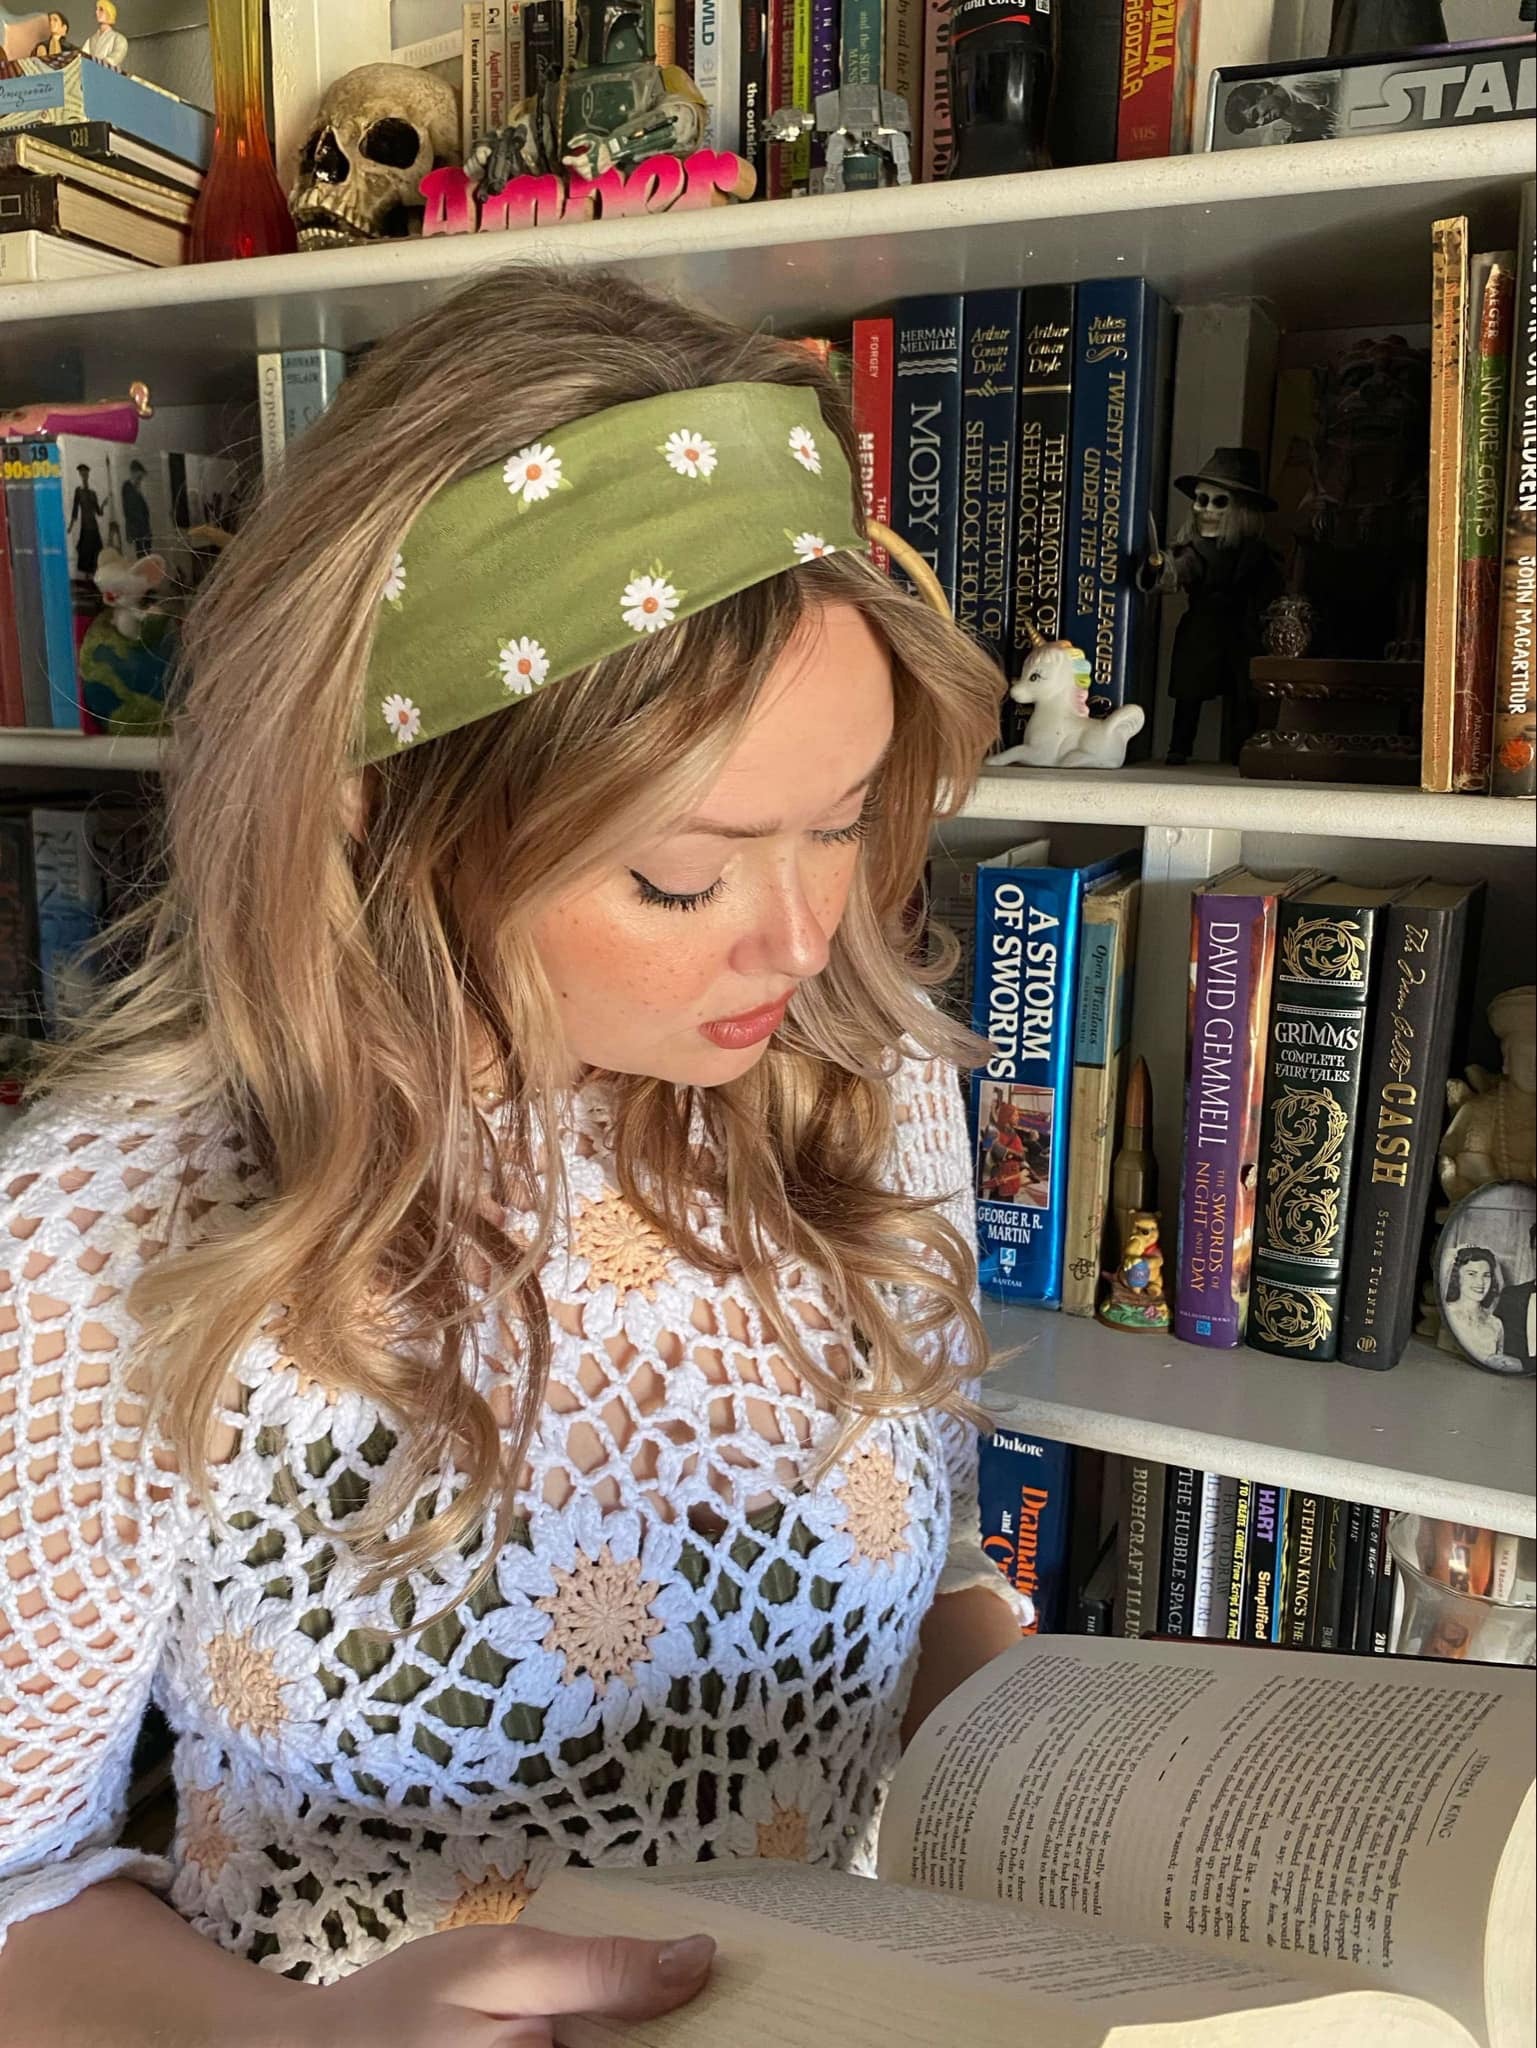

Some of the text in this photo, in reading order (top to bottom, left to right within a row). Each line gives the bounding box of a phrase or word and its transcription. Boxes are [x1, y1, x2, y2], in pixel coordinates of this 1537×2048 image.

[823, 7, 832, 27] IN
[898, 22, 909, 49] and
[897, 52, 910, 76] the
[746, 82, 758, 108] the
[900, 327, 956, 342] HERMAN
[970, 326, 1011, 344] Arthur
[1028, 323, 1070, 341] Arthur
[1087, 332, 1126, 345] Verne
[1088, 315, 1128, 331] Jules
[869, 336, 880, 378] FORGEY
[900, 338, 958, 353] MELVILLE
[971, 344, 1009, 359] Conan
[1028, 341, 1064, 355] Conan
[973, 358, 1007, 377] Doyle
[1029, 356, 1062, 376] Doyle
[32, 446, 49, 462] 19
[908, 400, 942, 536] MOBY
[1475, 376, 1504, 538] NATURE CRAFTS
[962, 420, 985, 552] SHERLOCK
[876, 497, 887, 521] THE
[982, 440, 1009, 641] THE RETURN OF
[1014, 421, 1041, 650] SHERLOCK HOLMES
[1036, 434, 1065, 636] THE MEMOIRS OF
[1077, 447, 1101, 617] UNDER THE SEA
[1094, 371, 1127, 686] TWENTY THOUSAND LEAGUES
[1509, 556, 1537, 714] JOHN MACARTHUR
[1471, 714, 1483, 772] MACMILLAN
[987, 883, 1025, 1079] OF SWORDS
[1021, 906, 1060, 1062] A STORM
[1089, 944, 1109, 1044] Open Windows
[1197, 920, 1240, 1148] DAVID GEMMELL
[1274, 1020, 1361, 1051] GRIMM'S
[1274, 1062, 1351, 1082] FAIRY TALES
[1280, 1049, 1346, 1067] COMPLETE
[1371, 1082, 1418, 1188] CASH
[977, 1206, 1044, 1230] GEORGE R. R.
[1190, 1161, 1211, 1294] NIGHT AND DAY
[1208, 1193, 1227, 1274] SWORDS
[987, 1224, 1031, 1245] MARTIN
[992, 1276, 1023, 1288] BANTAM
[1364, 1209, 1390, 1325] STEVE TURNER
[992, 1432, 1045, 1458] Dukore
[1240, 1486, 1249, 1497] TO
[1001, 1510, 1014, 1534] and
[1127, 1466, 1149, 1585] BUSHCRAFT
[1203, 1497, 1220, 1560] HUMAN
[1236, 1499, 1248, 1528] CREATE
[1257, 1489, 1276, 1543] HART
[1167, 1469, 1194, 1635] THE HUBBLE SPACE
[1216, 1493, 1234, 1596] HOW TO DRAW
[1234, 1529, 1246, 1559] COMICS
[1231, 1561, 1243, 1580] From
[1293, 1497, 1317, 1642] STEPHEN KING'S THE
[1198, 1565, 1215, 1627] FIGURE
[1229, 1581, 1241, 1606] Script
[1254, 1570, 1272, 1640] Simplified
[1374, 1632, 1387, 1645] 28
[1439, 1804, 1462, 1838] KING
[1093, 1881, 1102, 1915] would
[1186, 1857, 1202, 1933] never sleep
[1227, 1875, 1240, 1908] happy
[1164, 1912, 1172, 1929] the
[1214, 1906, 1223, 1937] when
[1240, 1900, 1251, 1943] hooded
[1281, 1871, 1294, 1950] corpse would
[1309, 1933, 1318, 1955] and
[1335, 1910, 1349, 1960] dropped
[1352, 1944, 1362, 1963] the
